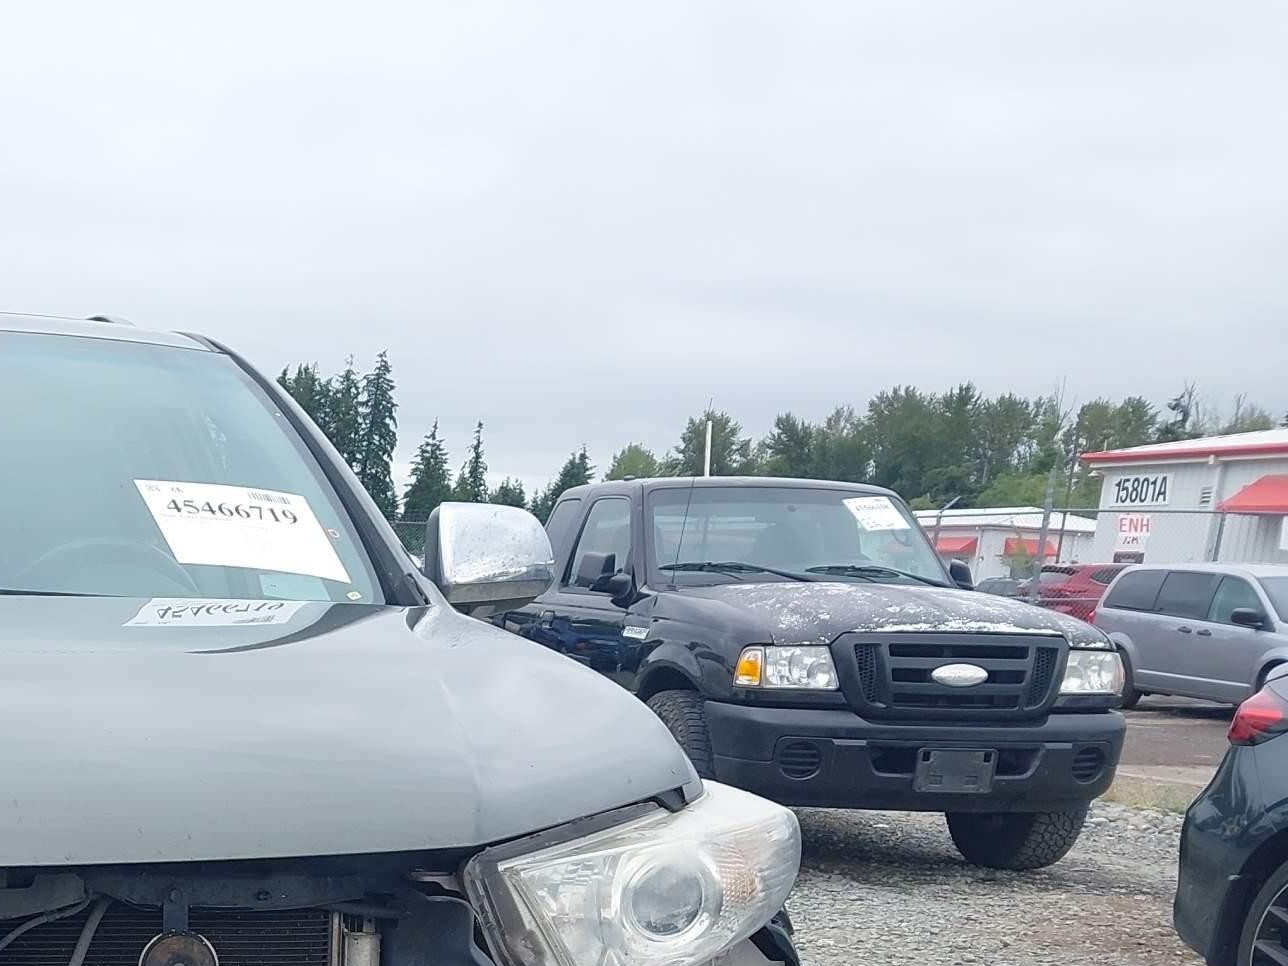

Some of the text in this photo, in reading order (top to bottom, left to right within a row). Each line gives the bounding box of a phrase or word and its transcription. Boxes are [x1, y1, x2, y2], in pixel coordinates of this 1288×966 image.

[1114, 476, 1168, 504] 15801A
[167, 498, 298, 525] 45466719
[1119, 518, 1150, 533] ENH
